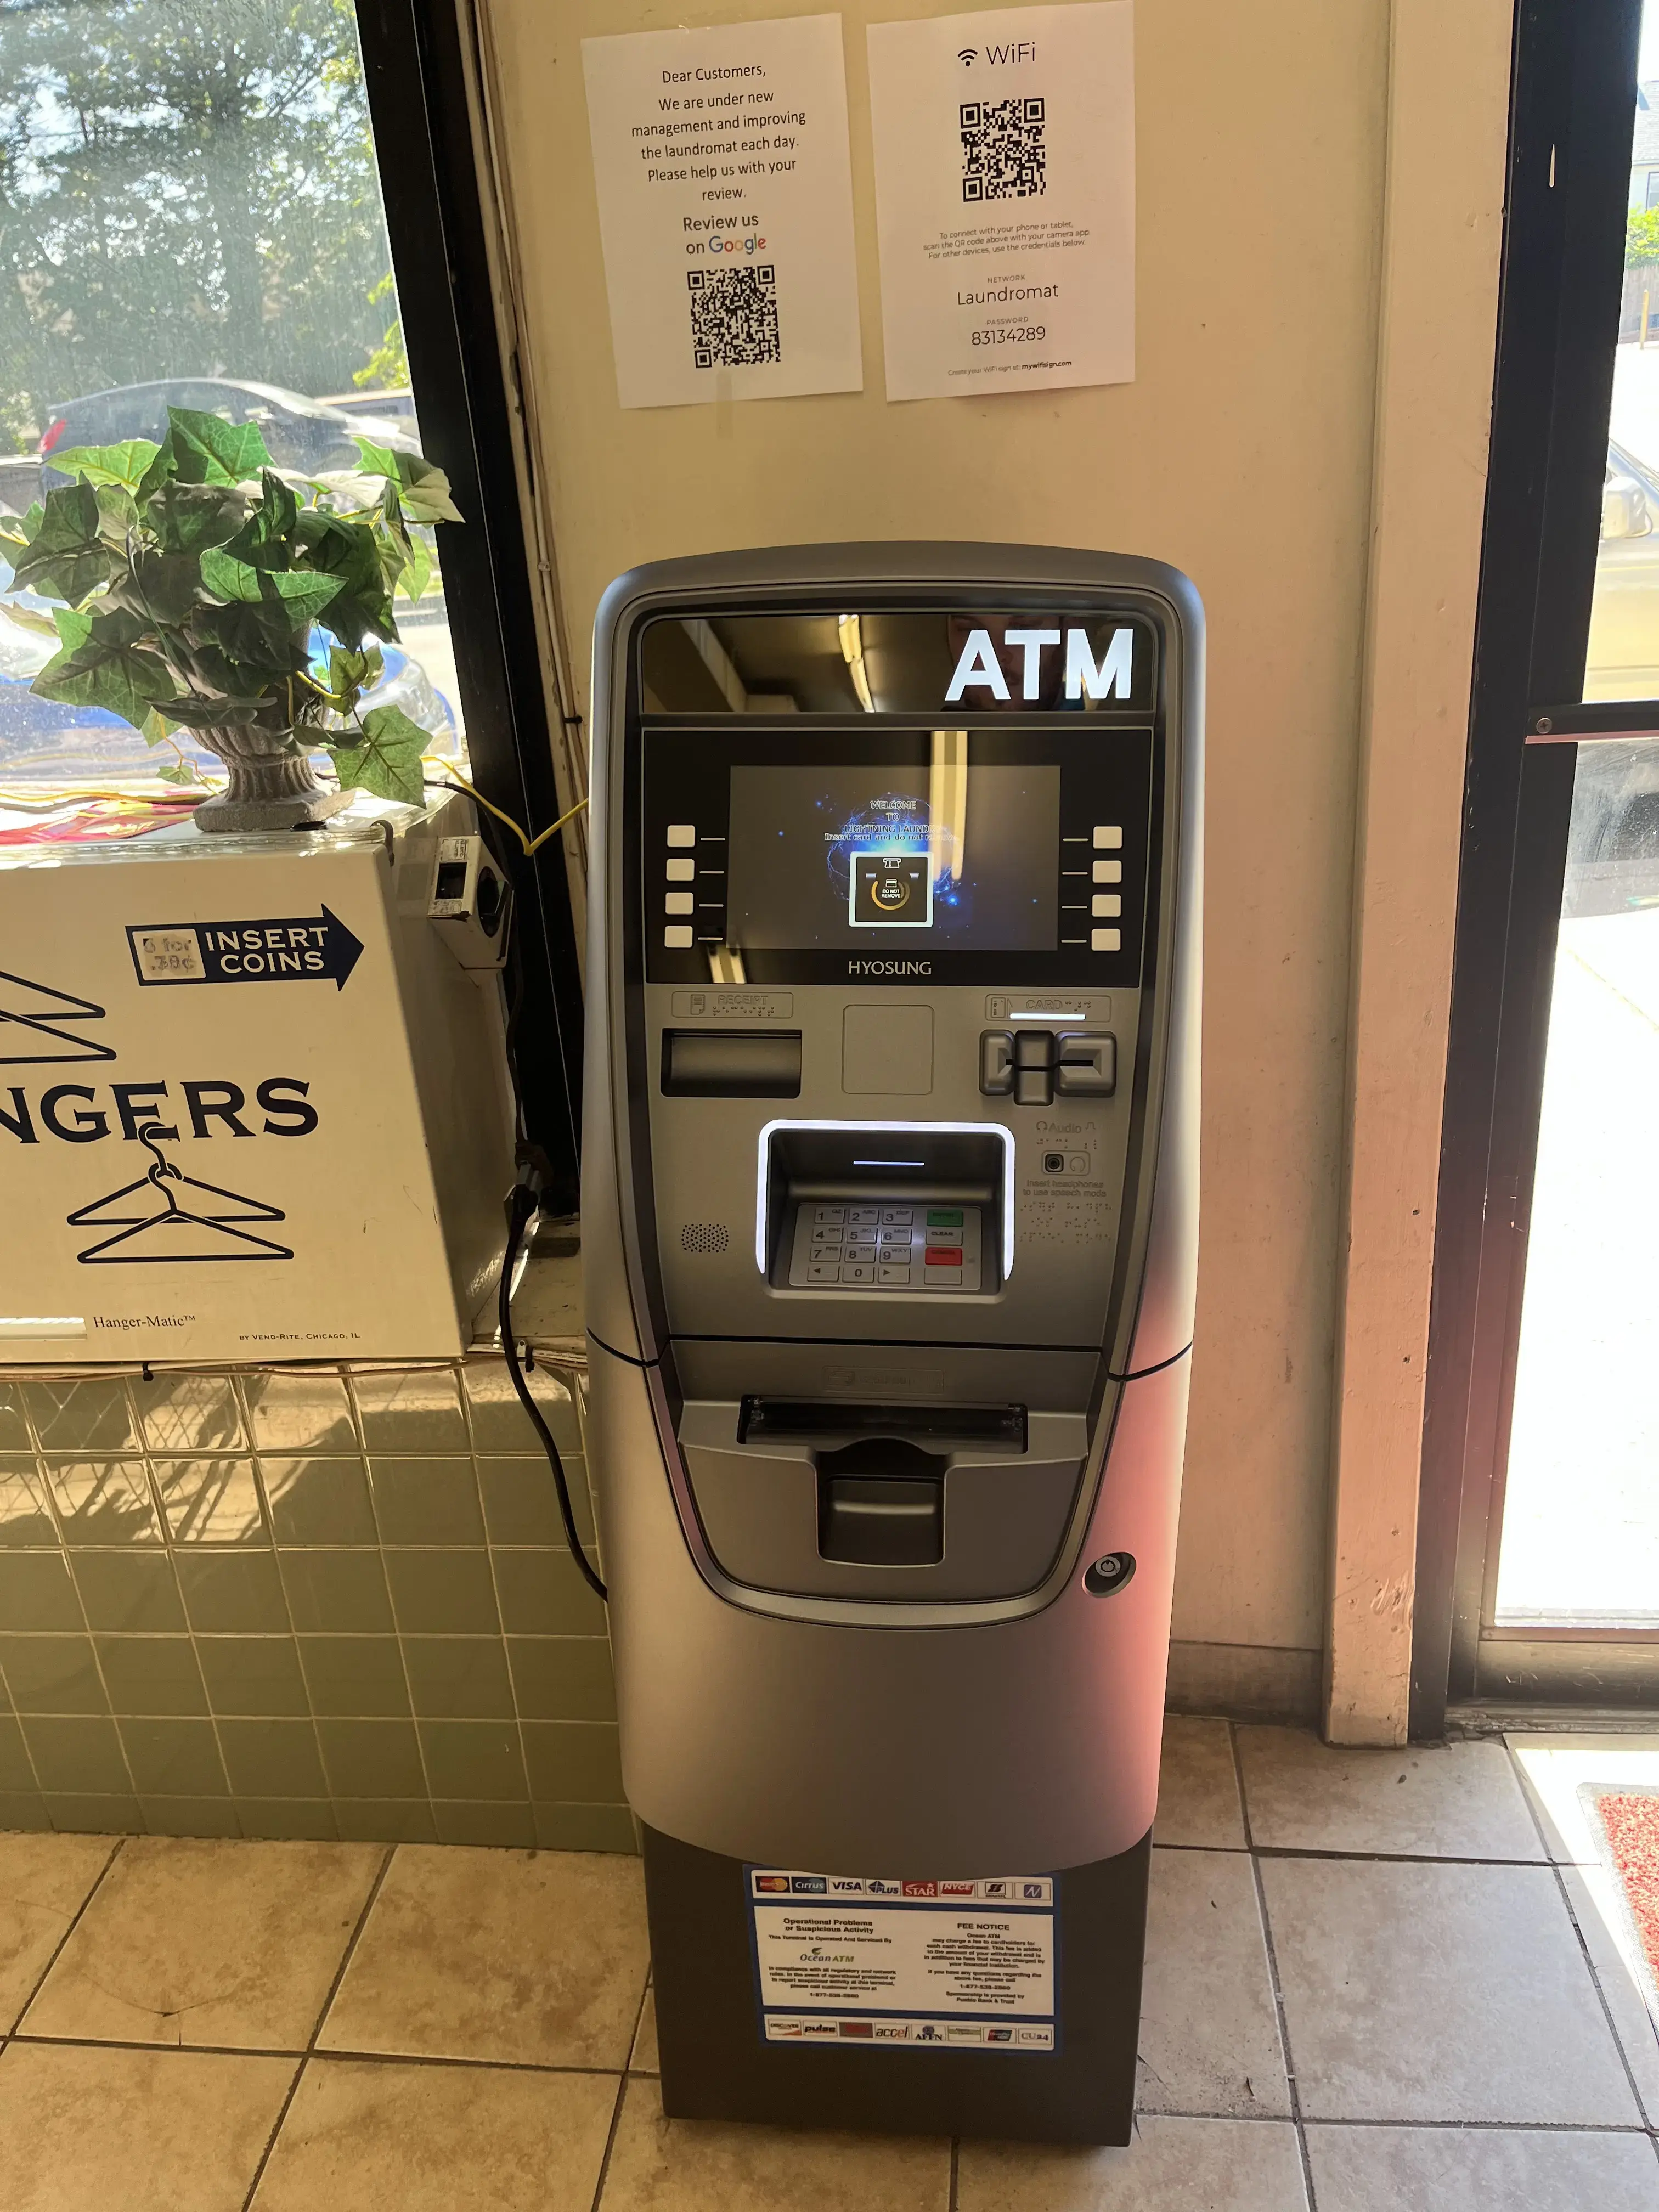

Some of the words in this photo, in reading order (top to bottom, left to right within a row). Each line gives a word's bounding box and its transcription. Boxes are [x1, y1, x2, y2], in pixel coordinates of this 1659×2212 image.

[986, 42, 1036, 65] WiFi
[663, 70, 691, 83] Dear
[696, 65, 766, 81] Customers,
[658, 98, 680, 110] We
[684, 98, 703, 109] are
[708, 93, 744, 107] under
[748, 92, 774, 103] new
[631, 120, 713, 137] management
[717, 116, 740, 129] and
[743, 111, 806, 129] improving
[641, 146, 662, 159] the
[665, 140, 737, 157] laundromat
[741, 137, 770, 151] each
[774, 135, 799, 149] day.
[648, 168, 687, 182] Please
[691, 165, 717, 180] help
[721, 166, 735, 176] us
[738, 160, 765, 174] with
[769, 160, 797, 175] your
[702, 187, 746, 201] review.
[683, 215, 737, 231] Review
[742, 215, 759, 227] us
[950, 229, 977, 239] connect
[997, 227, 1014, 235] your
[1016, 223, 1039, 232] phone
[686, 243, 705, 255] on
[709, 233, 766, 255] Google
[955, 240, 965, 248] QR
[967, 238, 984, 246] code
[986, 235, 1008, 244] above
[1010, 233, 1026, 241] with
[1028, 232, 1045, 241] your
[1046, 230, 1074, 239] camera
[943, 250, 961, 258] other
[962, 246, 990, 257] devices,
[1020, 240, 1060, 250] credentials
[988, 274, 1025, 283] NETWORK
[957, 284, 1059, 305] Laundromat
[986, 317, 1029, 325] PASSWORD
[972, 326, 1046, 346] 83134289
[1022, 360, 1072, 370] mywifisign.com
[944, 628, 1135, 701] ATM
[870, 800, 916, 810] WELCOME
[885, 812, 900, 821] TO
[844, 824, 896, 833] LIGHTNING
[825, 832, 851, 841] Insert
[875, 833, 891, 841] and
[909, 833, 923, 841] not
[205, 926, 328, 951] INSERT
[220, 951, 324, 974] COINS
[848, 961, 932, 975] HYOSUNG
[718, 994, 769, 1005] RECEIPT
[1025, 999, 1063, 1011] CARD
[1048, 1122, 1082, 1134] Audio
[1027, 1179, 1051, 1188] Insert
[1052, 1180, 1104, 1189] headphones
[1051, 1189, 1081, 1197] speech
[817, 1212, 823, 1221] 1
[851, 1212, 860, 1222] 2
[885, 1213, 894, 1222] 3
[816, 1230, 825, 1239] 4
[850, 1231, 858, 1240] 5
[884, 1232, 893, 1241] 6
[814, 1249, 822, 1259] 7
[848, 1250, 857, 1259] 8
[883, 1250, 891, 1260] 9
[854, 1268, 862, 1278] 0
[795, 1881, 824, 1889] Cirrus
[832, 1881, 862, 1891] VISA
[905, 1887, 935, 1897] STAR
[783, 1917, 832, 1926] Operational
[795, 1925, 841, 1933] Suspicious
[800, 1954, 831, 1962] Ocean
[805, 2024, 836, 2033] pulse
[876, 2026, 909, 2038] accel
